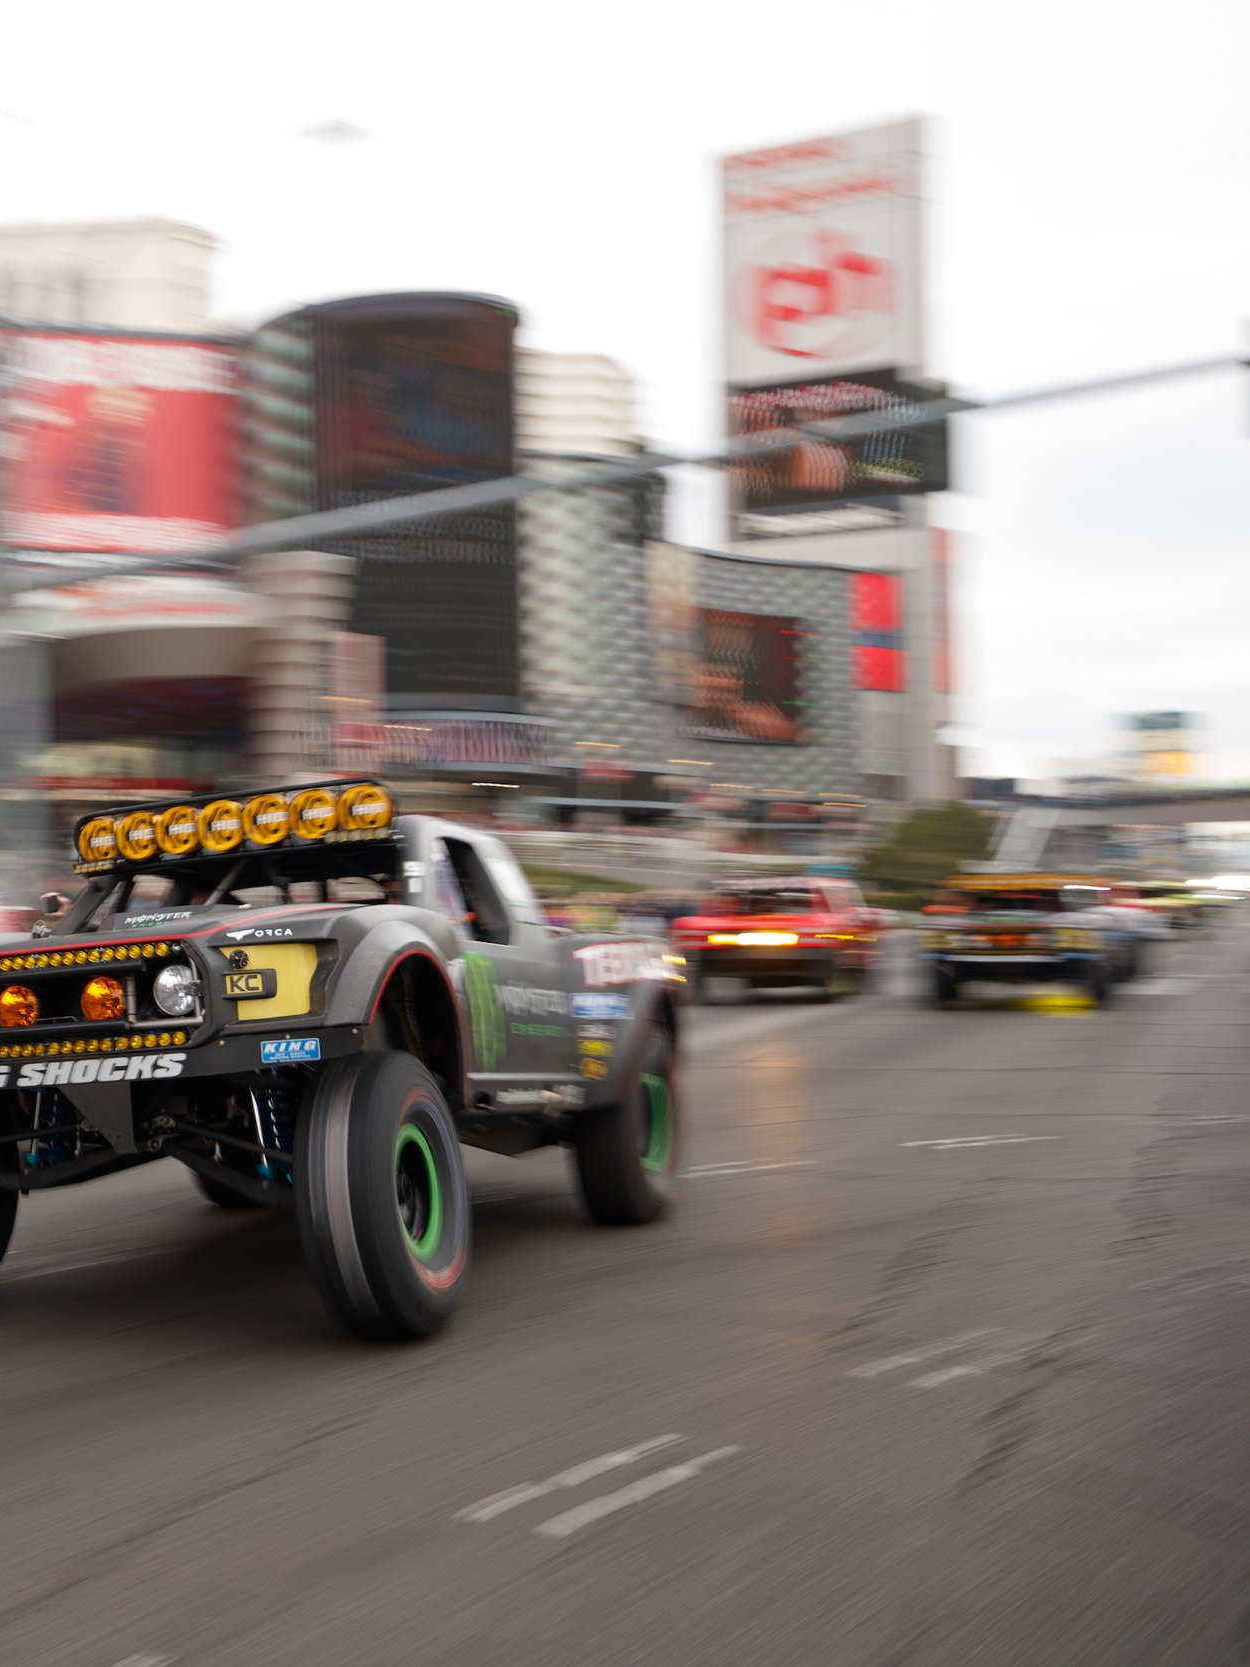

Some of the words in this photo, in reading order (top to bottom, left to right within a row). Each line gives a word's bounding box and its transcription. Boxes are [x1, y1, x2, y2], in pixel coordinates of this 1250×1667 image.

[254, 928, 293, 937] ORCA
[229, 975, 260, 993] KC
[264, 1040, 317, 1054] KING
[16, 1053, 188, 1088] SHOCKS
